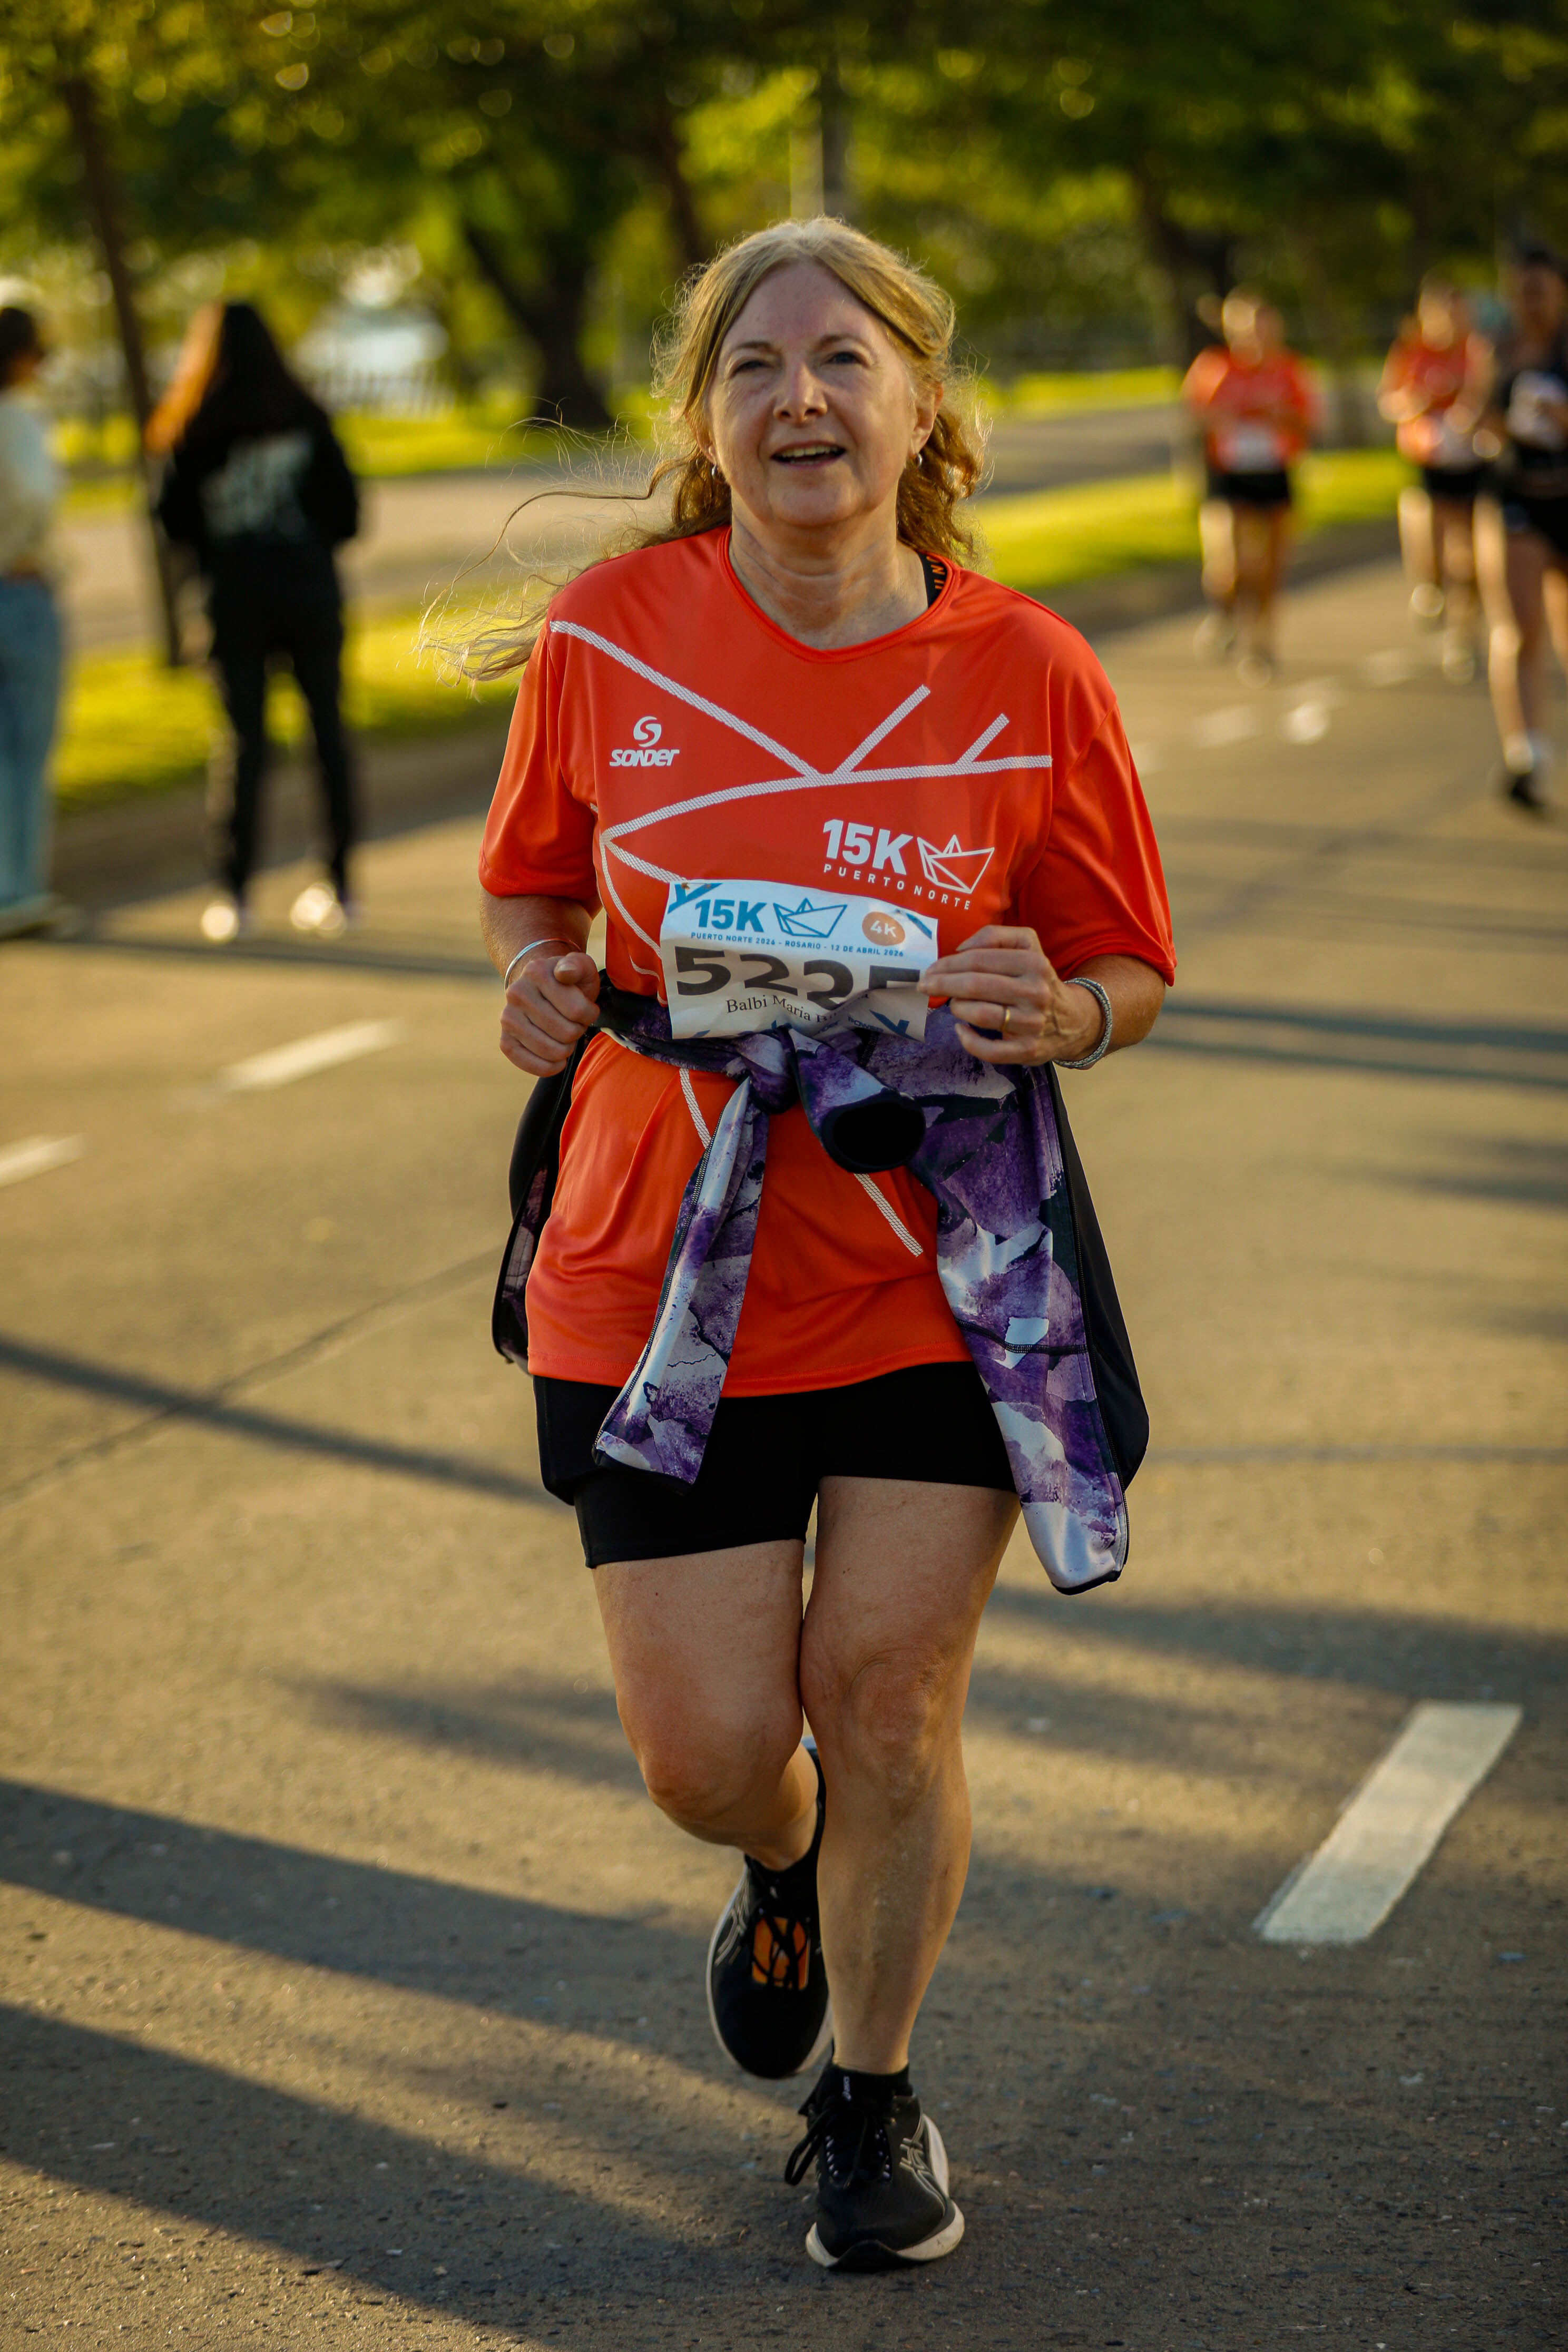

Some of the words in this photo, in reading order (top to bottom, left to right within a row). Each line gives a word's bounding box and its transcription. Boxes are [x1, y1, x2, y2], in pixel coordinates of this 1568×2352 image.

[823, 819, 913, 875] 15K
[824, 864, 904, 889] PUERTO
[914, 885, 971, 910] NORTE
[695, 899, 767, 932] 15K
[870, 920, 896, 937] 4K
[691, 932, 723, 940] PUERTO
[785, 940, 821, 949] ROSARIO
[726, 995, 768, 1013] Balbi
[772, 995, 811, 1021] Maria
